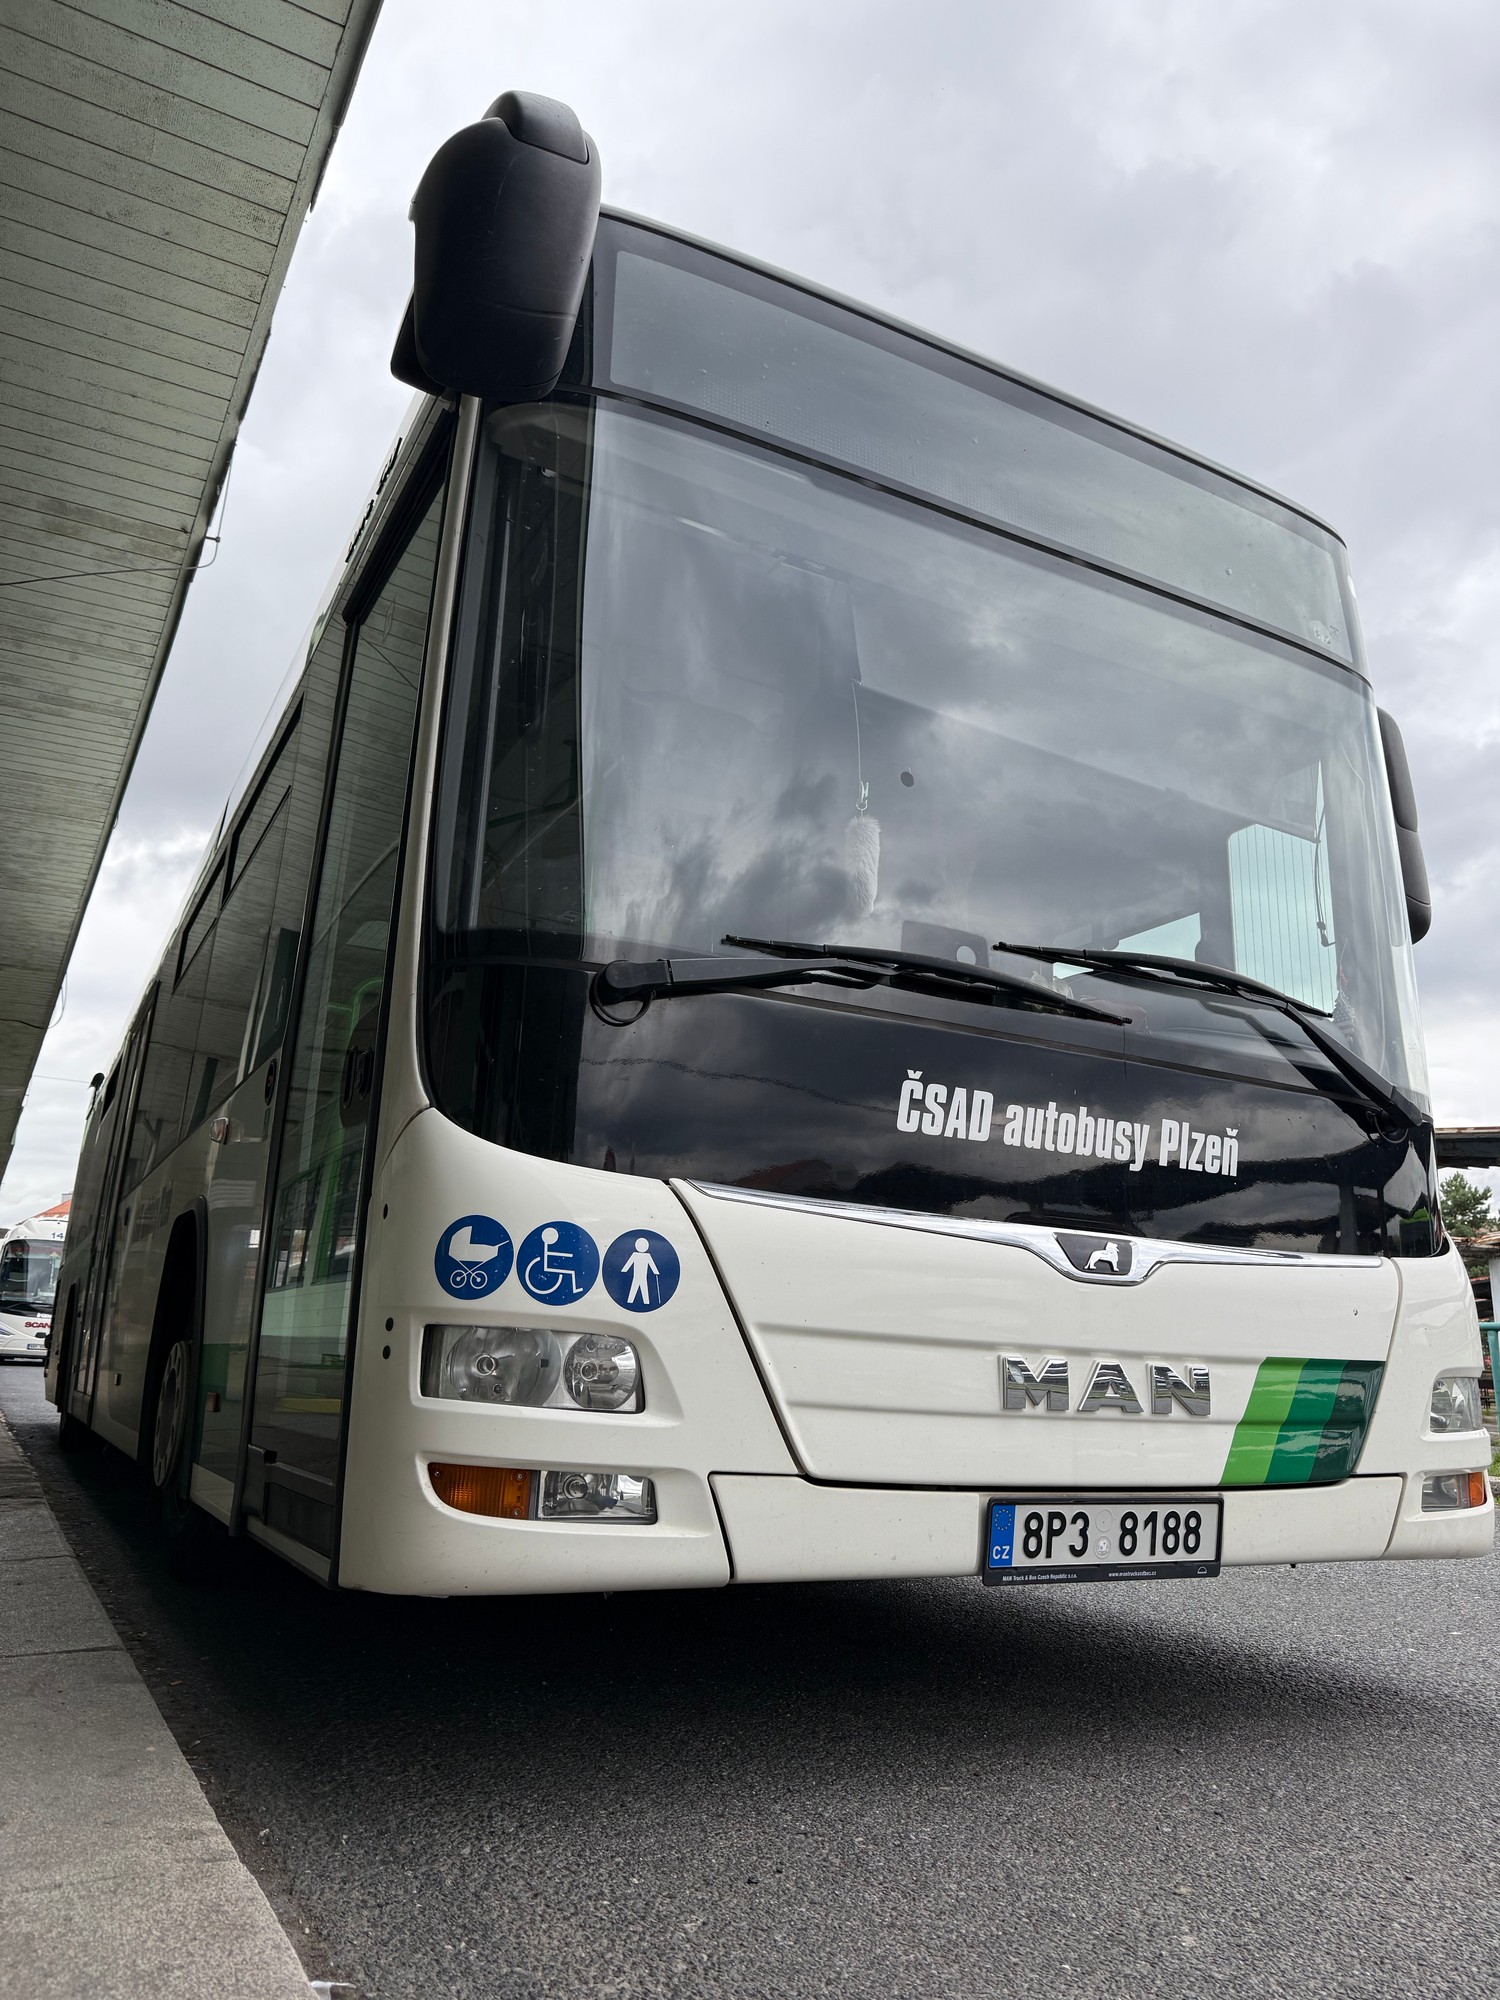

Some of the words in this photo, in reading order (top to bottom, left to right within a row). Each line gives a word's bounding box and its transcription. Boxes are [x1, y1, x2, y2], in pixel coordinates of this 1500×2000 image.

[896, 1069, 995, 1142] ČSAD
[1003, 1101, 1151, 1173] autobusy
[1158, 1119, 1240, 1178] Plzeň
[998, 1353, 1212, 1416] MAN
[992, 1545, 1010, 1560] CZ
[1022, 1510, 1090, 1559] 8P3
[1118, 1510, 1203, 1557] 8188
